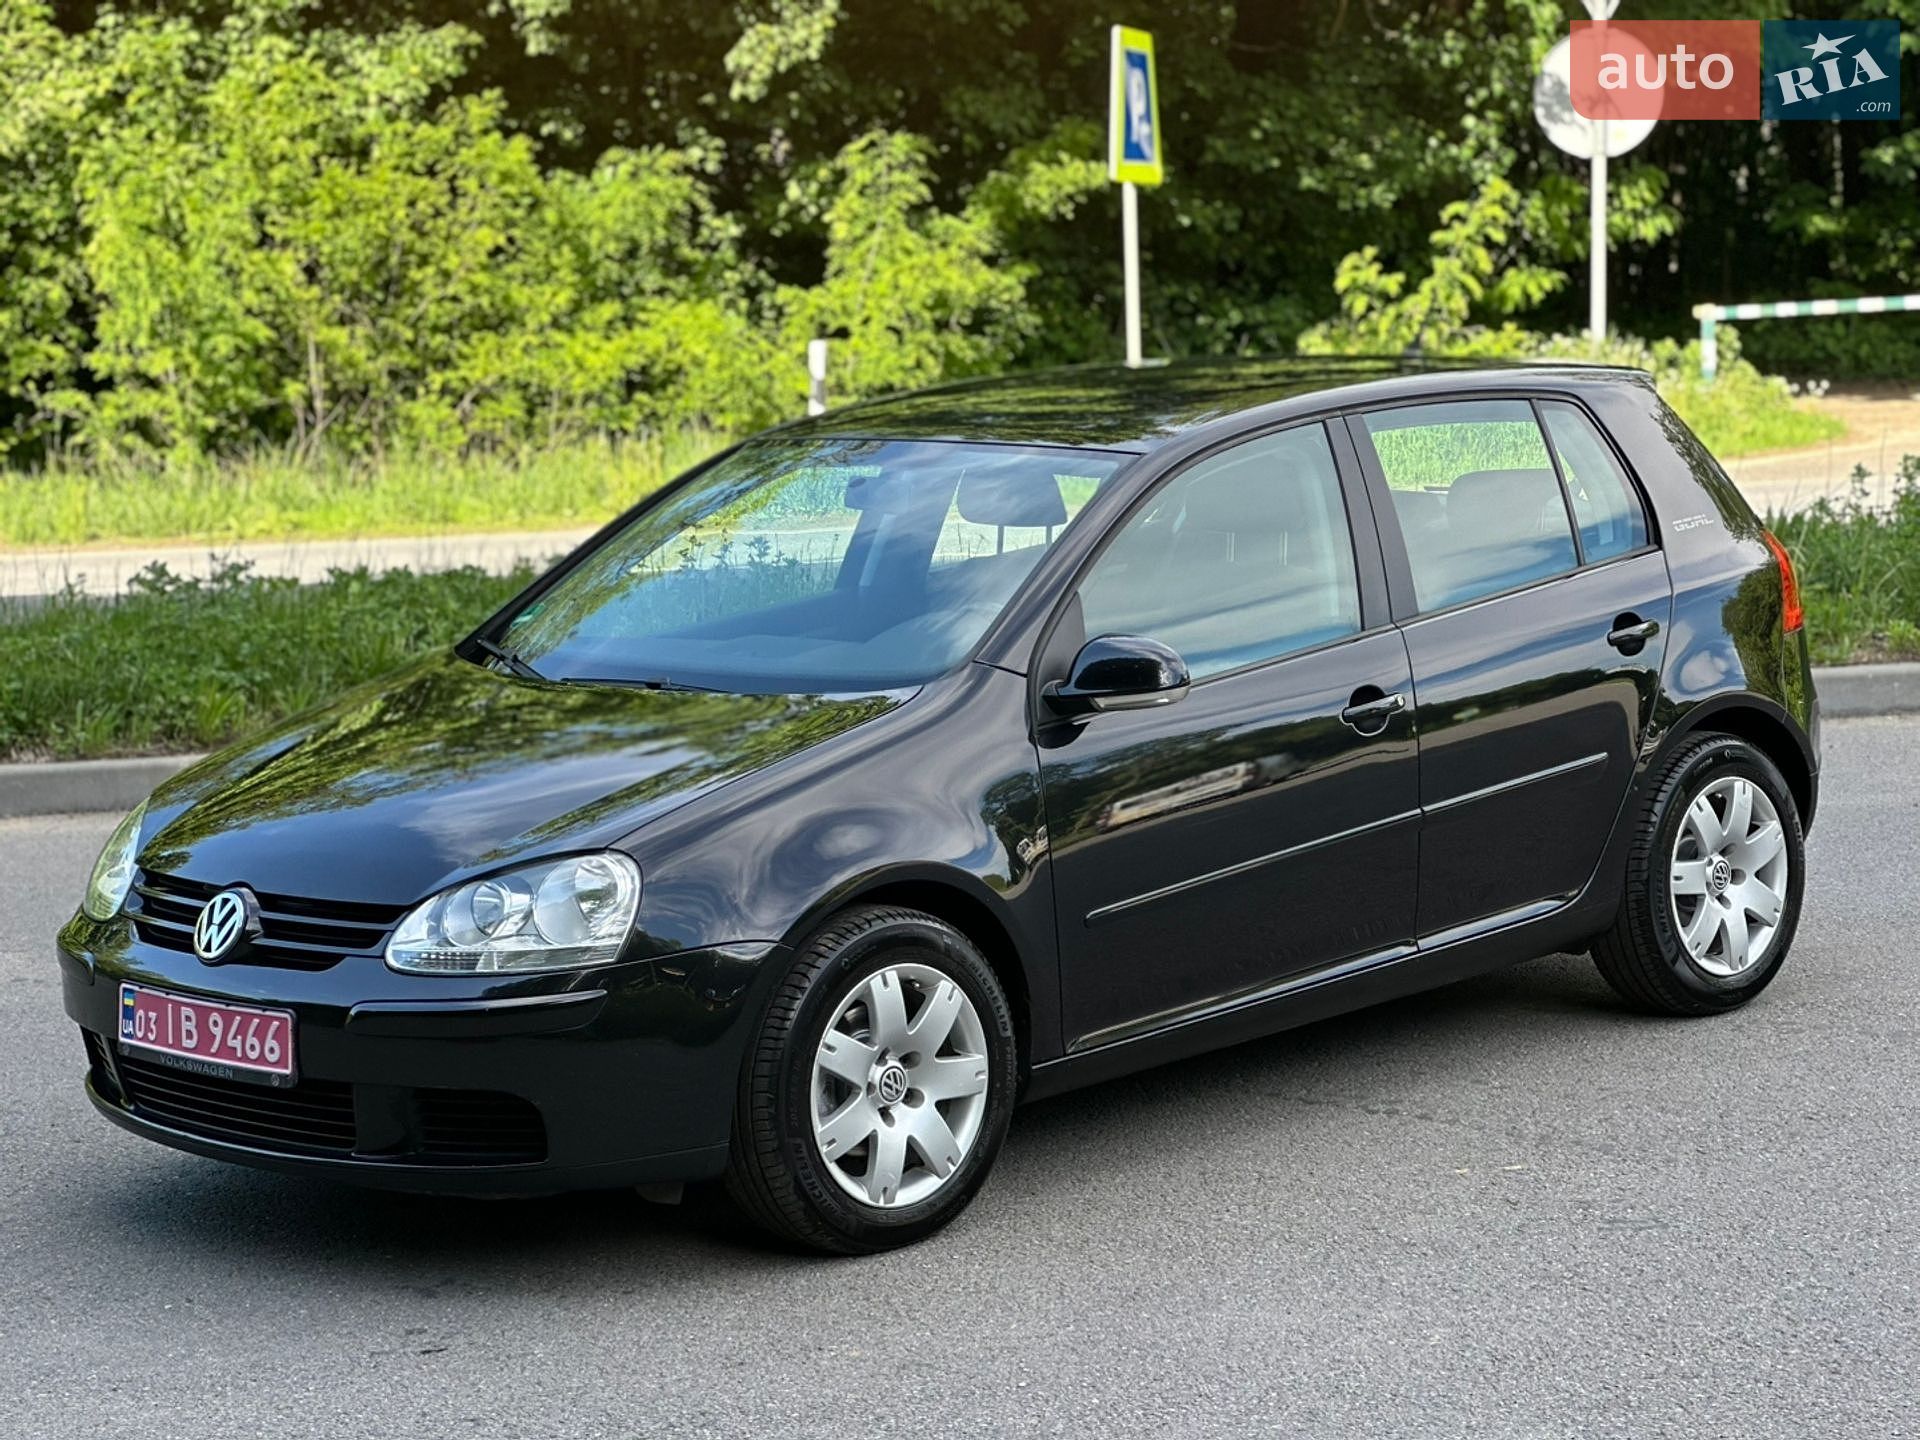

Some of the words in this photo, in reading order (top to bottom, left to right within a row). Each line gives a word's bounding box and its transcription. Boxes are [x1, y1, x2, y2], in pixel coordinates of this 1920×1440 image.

[122, 1018, 134, 1035] UA
[135, 1009, 157, 1041] 03
[167, 1003, 198, 1049] IB
[208, 1012, 281, 1063] 9466
[159, 1054, 234, 1079] VOLKSWAGEN
